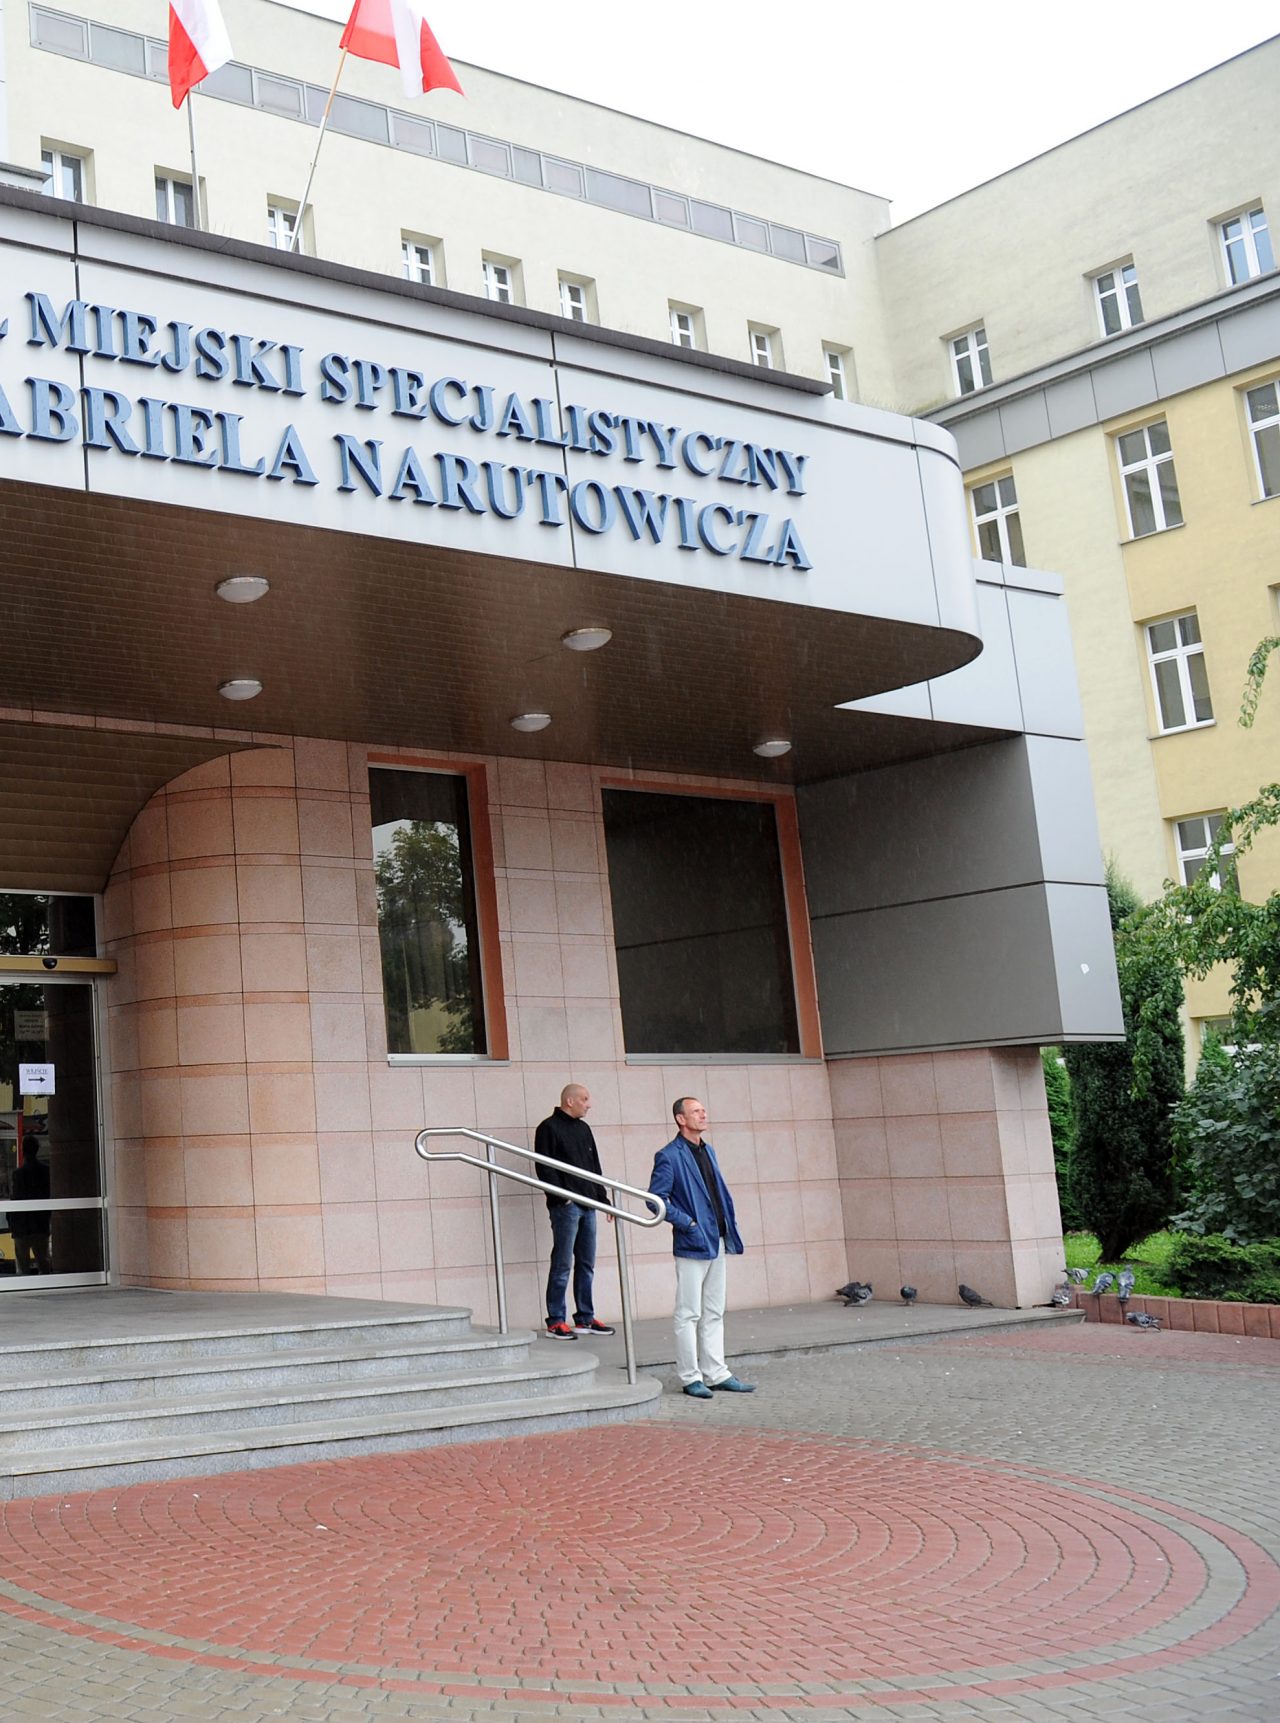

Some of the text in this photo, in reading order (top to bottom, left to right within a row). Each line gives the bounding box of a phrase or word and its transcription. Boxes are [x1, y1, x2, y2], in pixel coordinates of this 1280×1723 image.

[24, 290, 307, 398] MIEJSKI
[320, 351, 811, 497] SPECJALISTYCZNY
[333, 432, 814, 572] NARUTOWICZA
